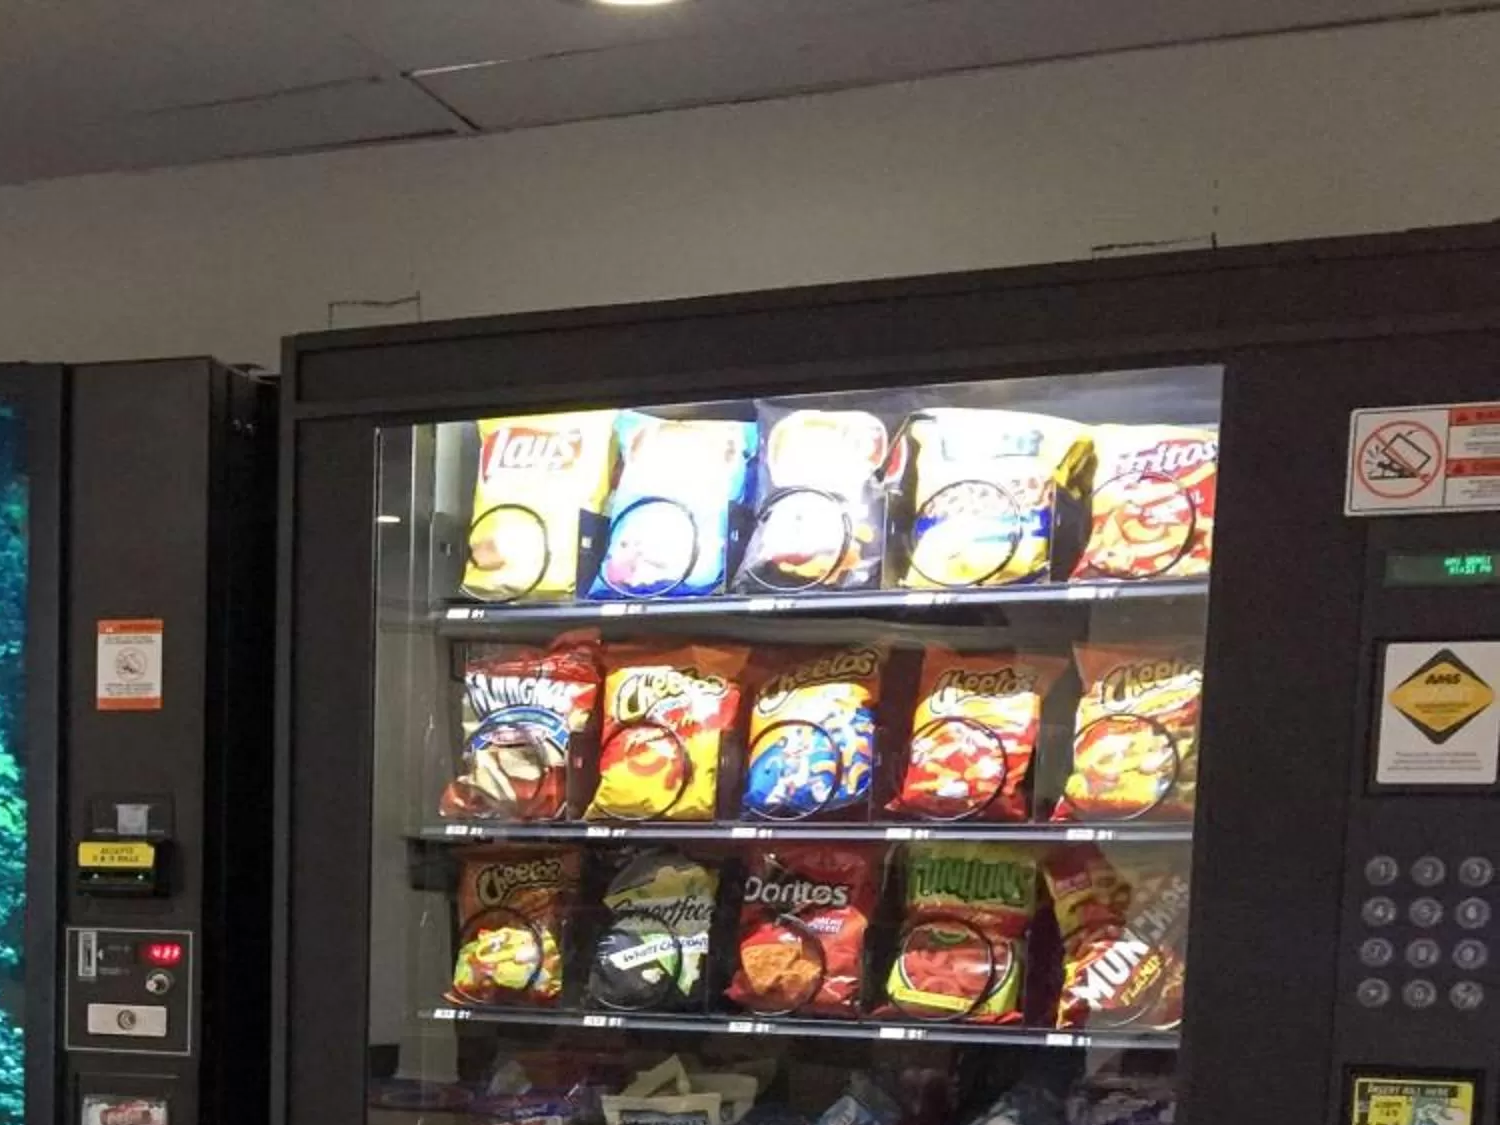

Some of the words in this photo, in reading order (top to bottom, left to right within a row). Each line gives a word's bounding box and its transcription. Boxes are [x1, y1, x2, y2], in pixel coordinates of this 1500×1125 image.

[757, 648, 877, 715] Cheetos
[929, 666, 1036, 716] Cheetos
[743, 875, 851, 907] Doritos
